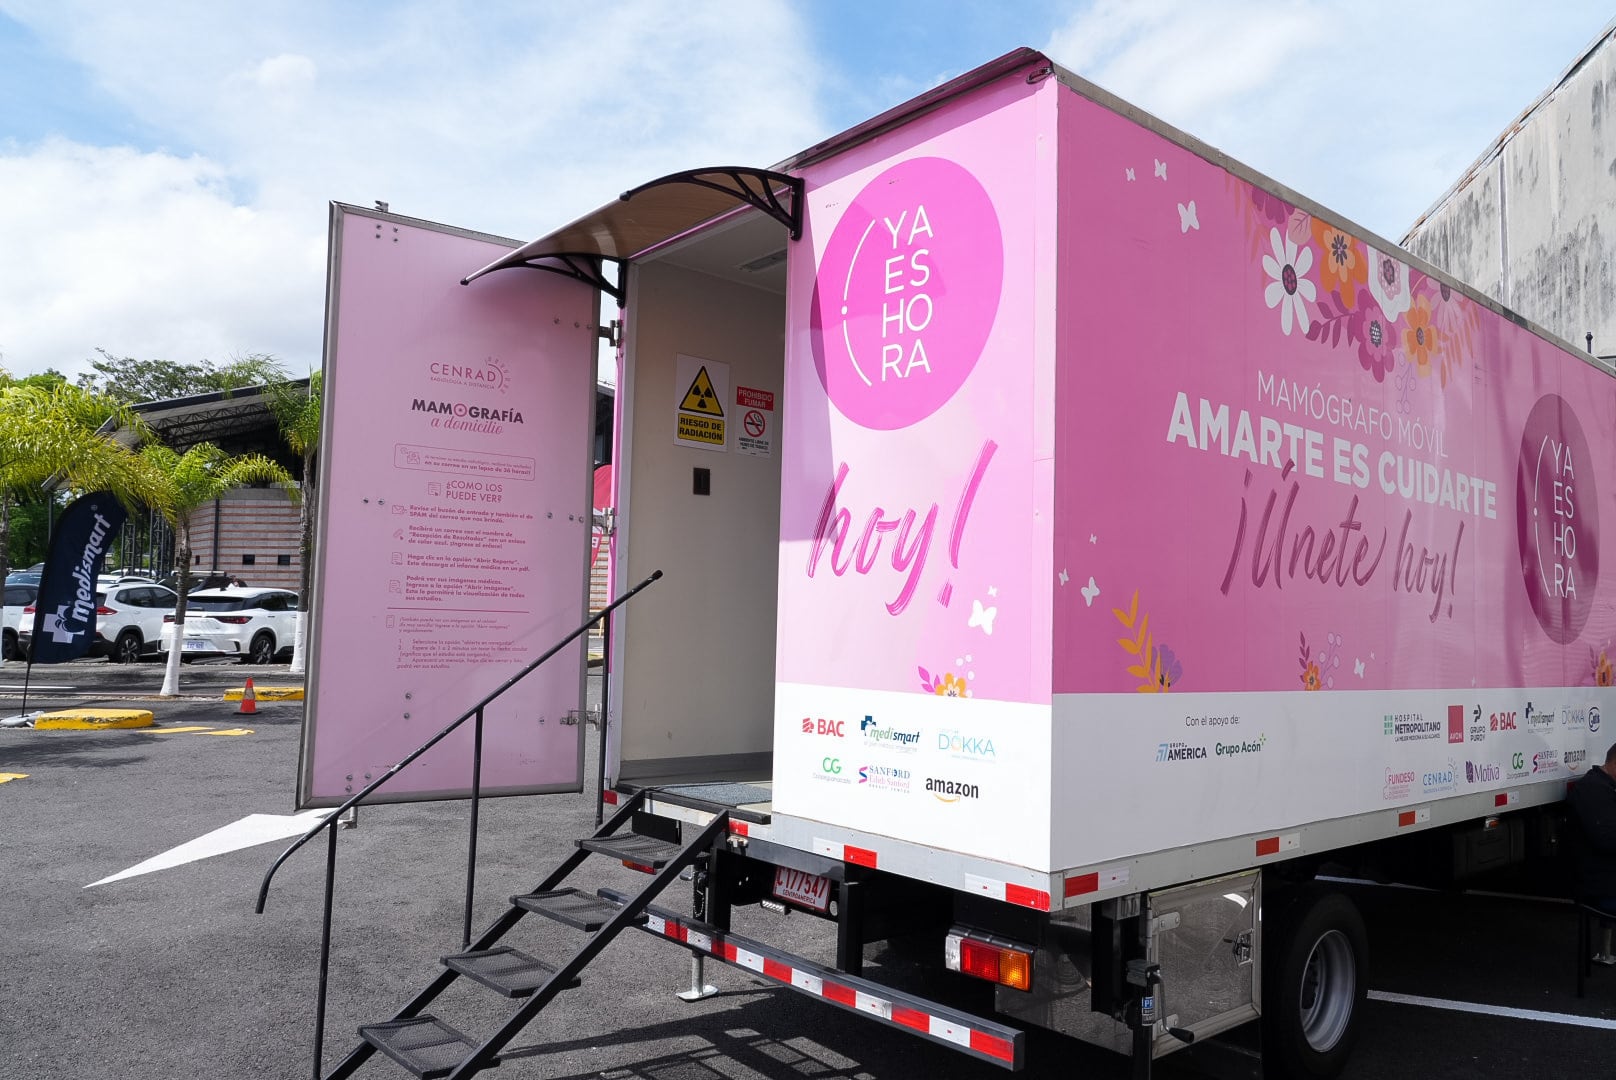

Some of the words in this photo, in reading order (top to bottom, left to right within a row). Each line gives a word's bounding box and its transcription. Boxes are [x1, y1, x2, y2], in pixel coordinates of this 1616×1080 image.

[884, 204, 934, 249] YA
[885, 249, 930, 294] ES
[430, 362, 496, 382] CENRAD
[739, 390, 772, 401] PROHIBIDO
[745, 399, 765, 408] FUMAR
[412, 398, 524, 424] MAMOGRAFÍA
[1258, 370, 1392, 440] MAMÓGRAFO
[1398, 417, 1448, 458] MÓVIL
[430, 418, 441, 429] a
[444, 416, 503, 434] domicilio
[680, 418, 709, 428] RIESGO
[712, 422, 721, 431] DE
[1166, 392, 1324, 478] AMARTE
[1334, 437, 1370, 489] ES
[1378, 451, 1496, 519] CUIDARTE
[1552, 440, 1574, 480] YA
[446, 491, 476, 501] PUEDE
[479, 493, 502, 502] VER?
[486, 484, 502, 492] LOS
[1554, 480, 1574, 518] ES
[806, 439, 998, 616] hoy!
[72, 512, 112, 624] medismart
[1394, 508, 1464, 623] hoy!
[1185, 716, 1199, 726] Con
[1201, 716, 1207, 726] el
[1208, 716, 1228, 727] apoyo
[1395, 713, 1423, 722] HOSPITAL
[1500, 712, 1517, 730] BAC
[817, 719, 845, 737] BAC
[870, 728, 920, 744] medismart
[1395, 722, 1441, 735] METROPOLITANO
[1216, 743, 1240, 757] Grupo
[1241, 741, 1261, 753] Acón
[1564, 750, 1586, 764] amazon
[823, 757, 841, 774] CG
[1512, 752, 1524, 770] CG
[1388, 771, 1415, 785] FUNDESO
[1423, 771, 1453, 786] CENRAD
[1474, 764, 1500, 783] Motiva
[926, 777, 979, 798] amazon
